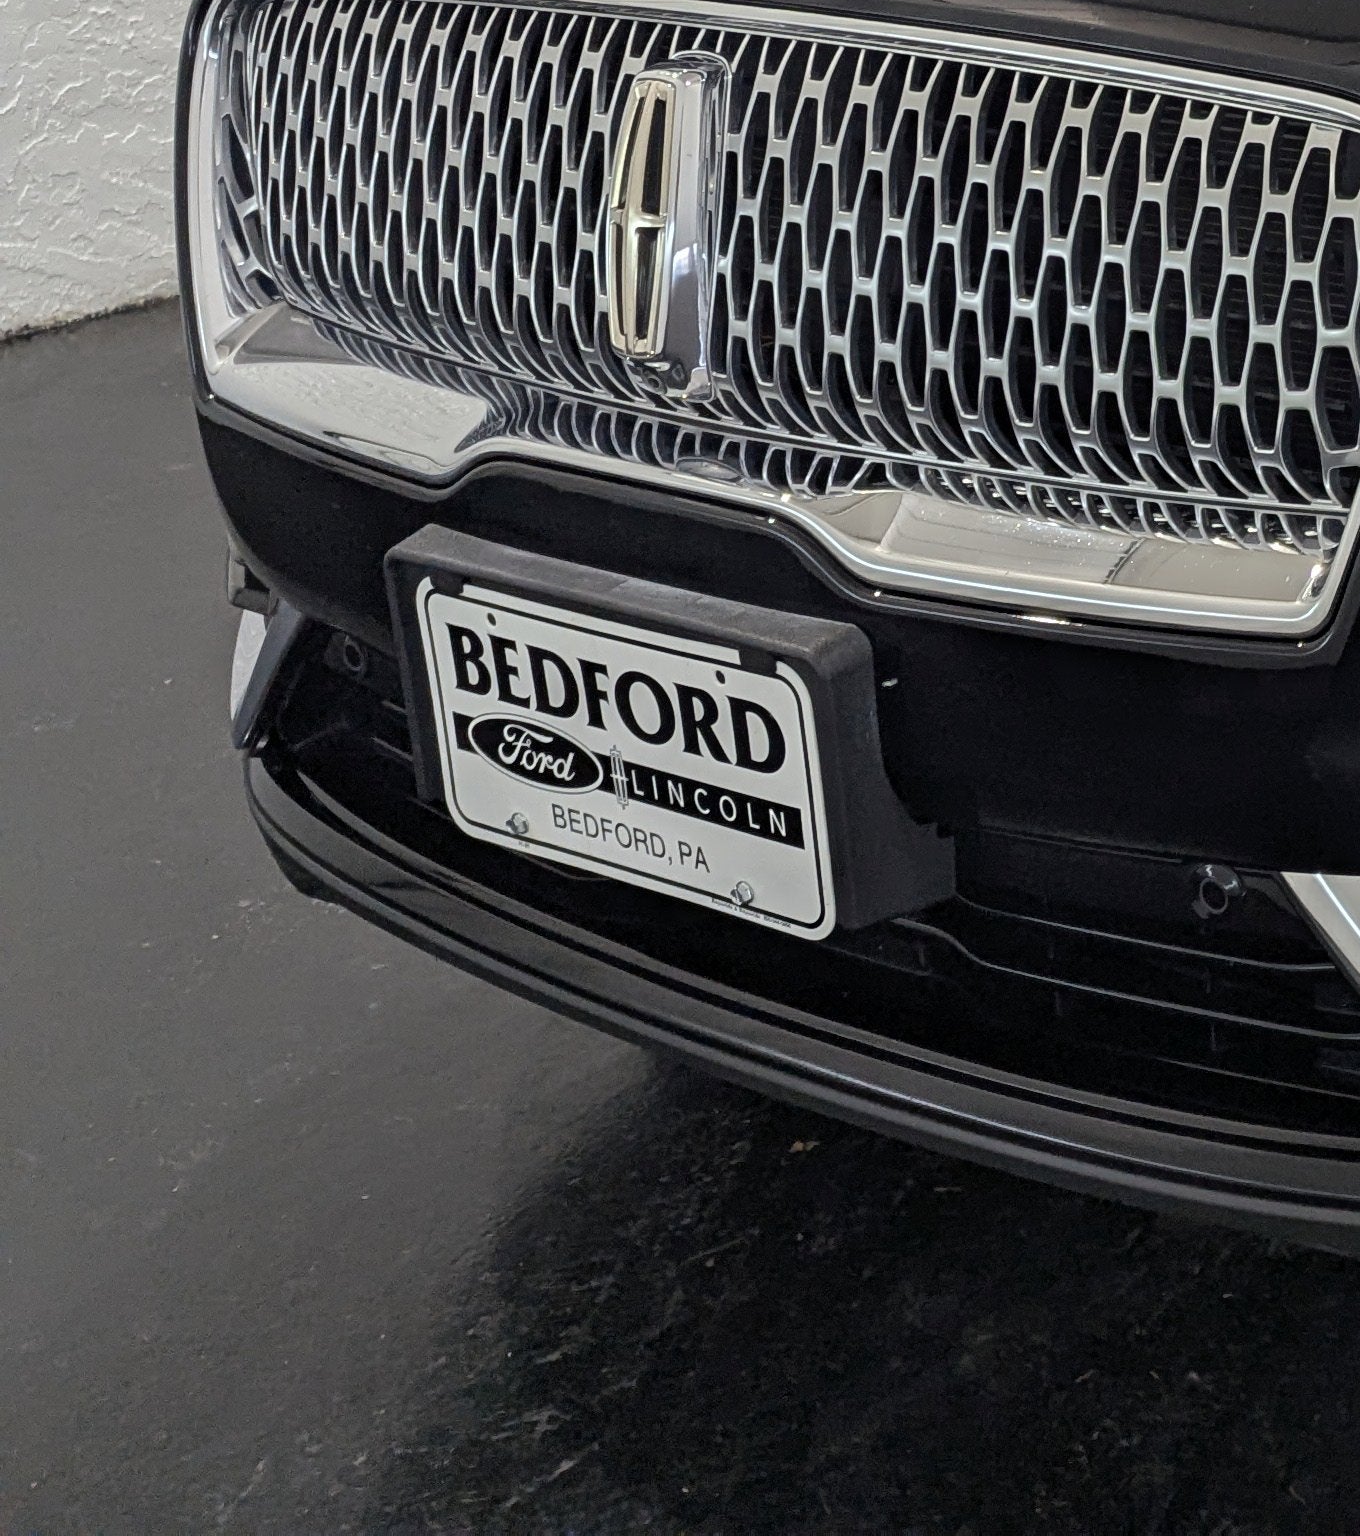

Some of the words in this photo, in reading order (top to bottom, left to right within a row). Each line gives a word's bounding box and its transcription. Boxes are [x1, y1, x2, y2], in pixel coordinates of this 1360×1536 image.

[445, 622, 787, 775] BEDFORD
[497, 723, 576, 782] Ford
[631, 769, 787, 838] LINCOLN
[551, 802, 673, 866] BEDFORD,
[678, 840, 711, 874] PA
